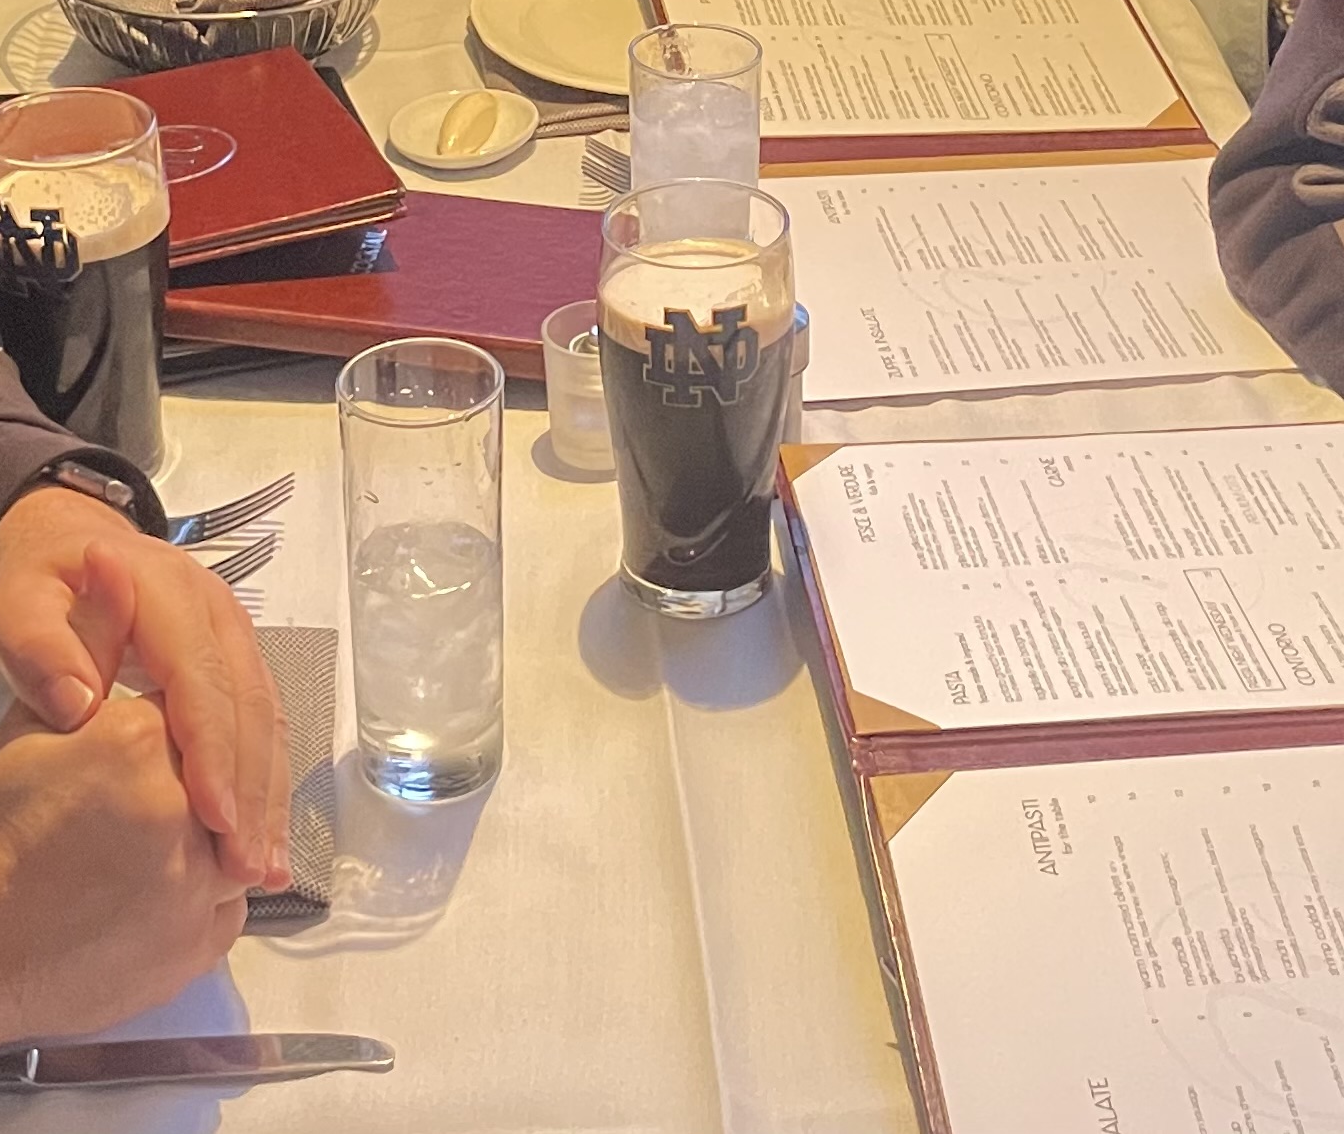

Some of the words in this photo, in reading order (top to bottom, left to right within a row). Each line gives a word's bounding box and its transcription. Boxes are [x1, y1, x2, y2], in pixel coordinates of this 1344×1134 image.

[979, 73, 1009, 117] CONTORNO
[837, 464, 862, 504] VERDURE
[1038, 457, 1064, 487] CARNE
[852, 506, 867, 514] &
[853, 516, 875, 542] PESCE
[1268, 623, 1315, 685] CONTORNO
[944, 670, 970, 704] PASTA
[1049, 797, 1063, 821] table
[1021, 799, 1057, 875] ANTIPASTI
[1057, 823, 1068, 839] the
[1061, 841, 1072, 854] for
[1110, 875, 1125, 901] olives
[1118, 904, 1141, 956] marinated
[1303, 904, 1326, 940] cocktail
[1136, 958, 1151, 989] warm
[1320, 942, 1339, 975] shrimp
[1087, 1077, 1117, 1130] ALATE
